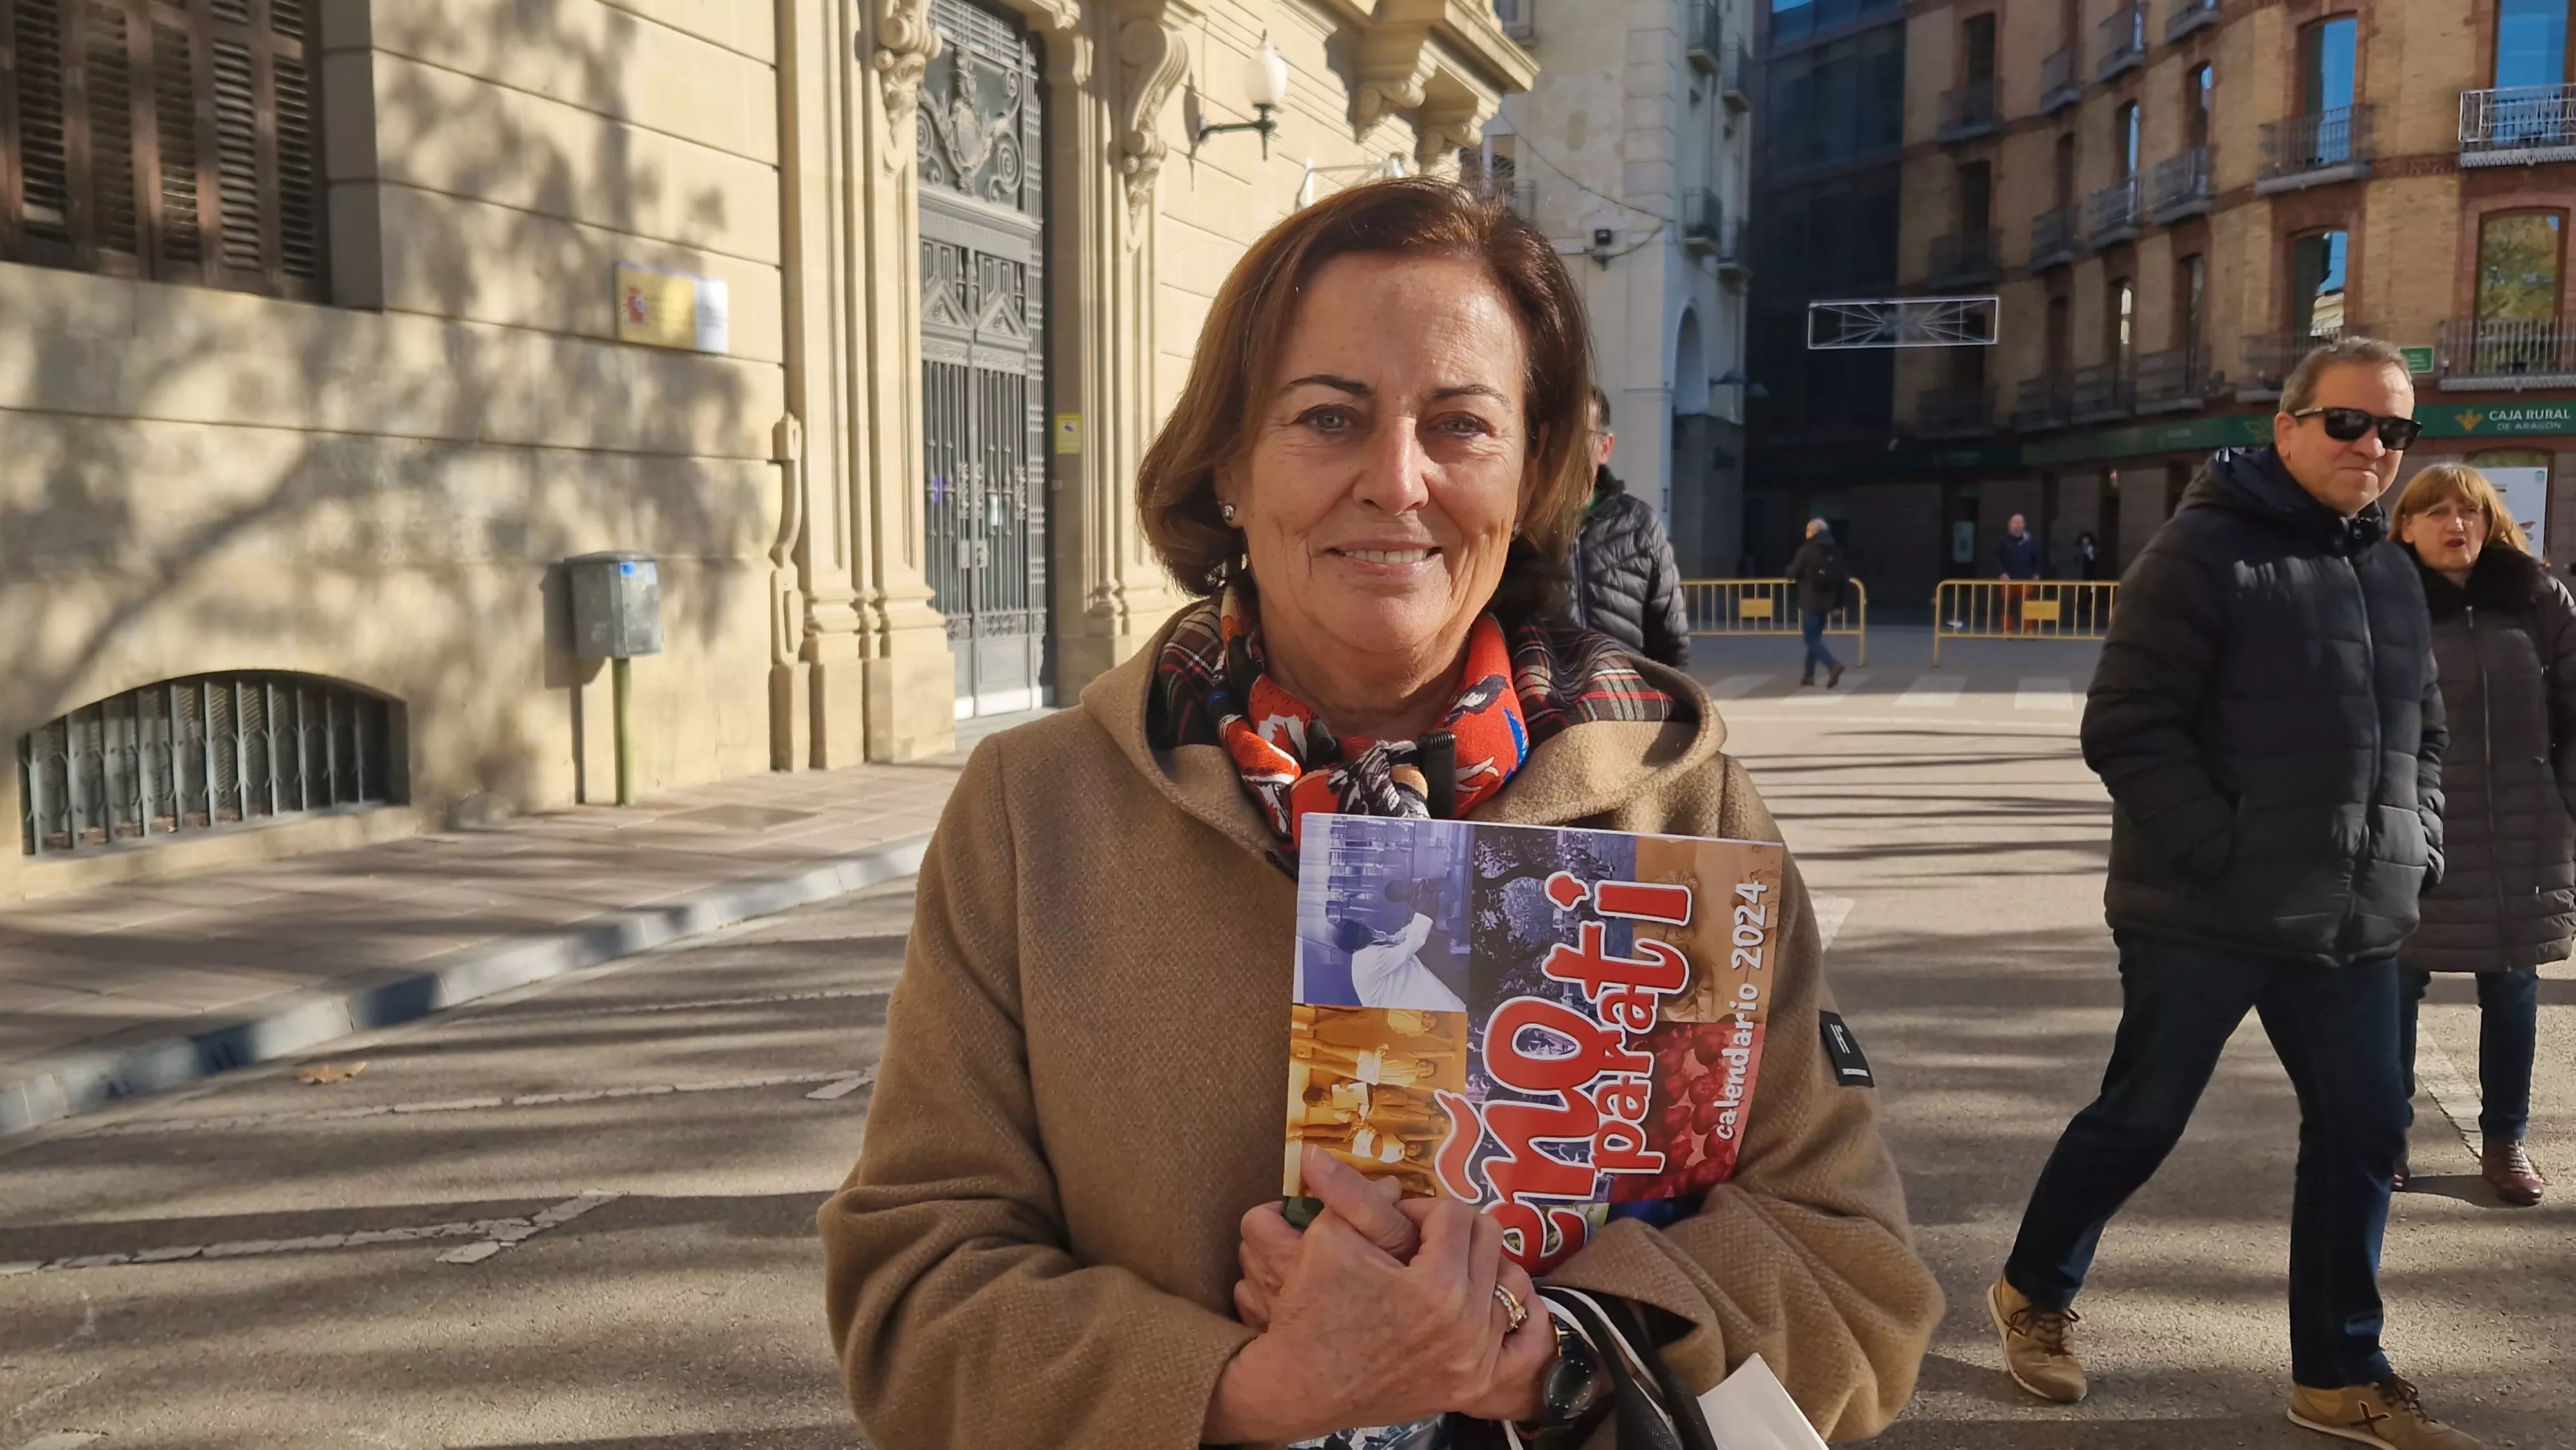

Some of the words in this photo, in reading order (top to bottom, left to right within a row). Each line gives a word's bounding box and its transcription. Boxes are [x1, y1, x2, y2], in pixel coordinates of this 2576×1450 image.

[2489, 410, 2523, 420] CAJA
[2526, 409, 2571, 420] RURAL
[1731, 880, 1767, 970] 2024
[1713, 983, 1759, 1140] calendario
